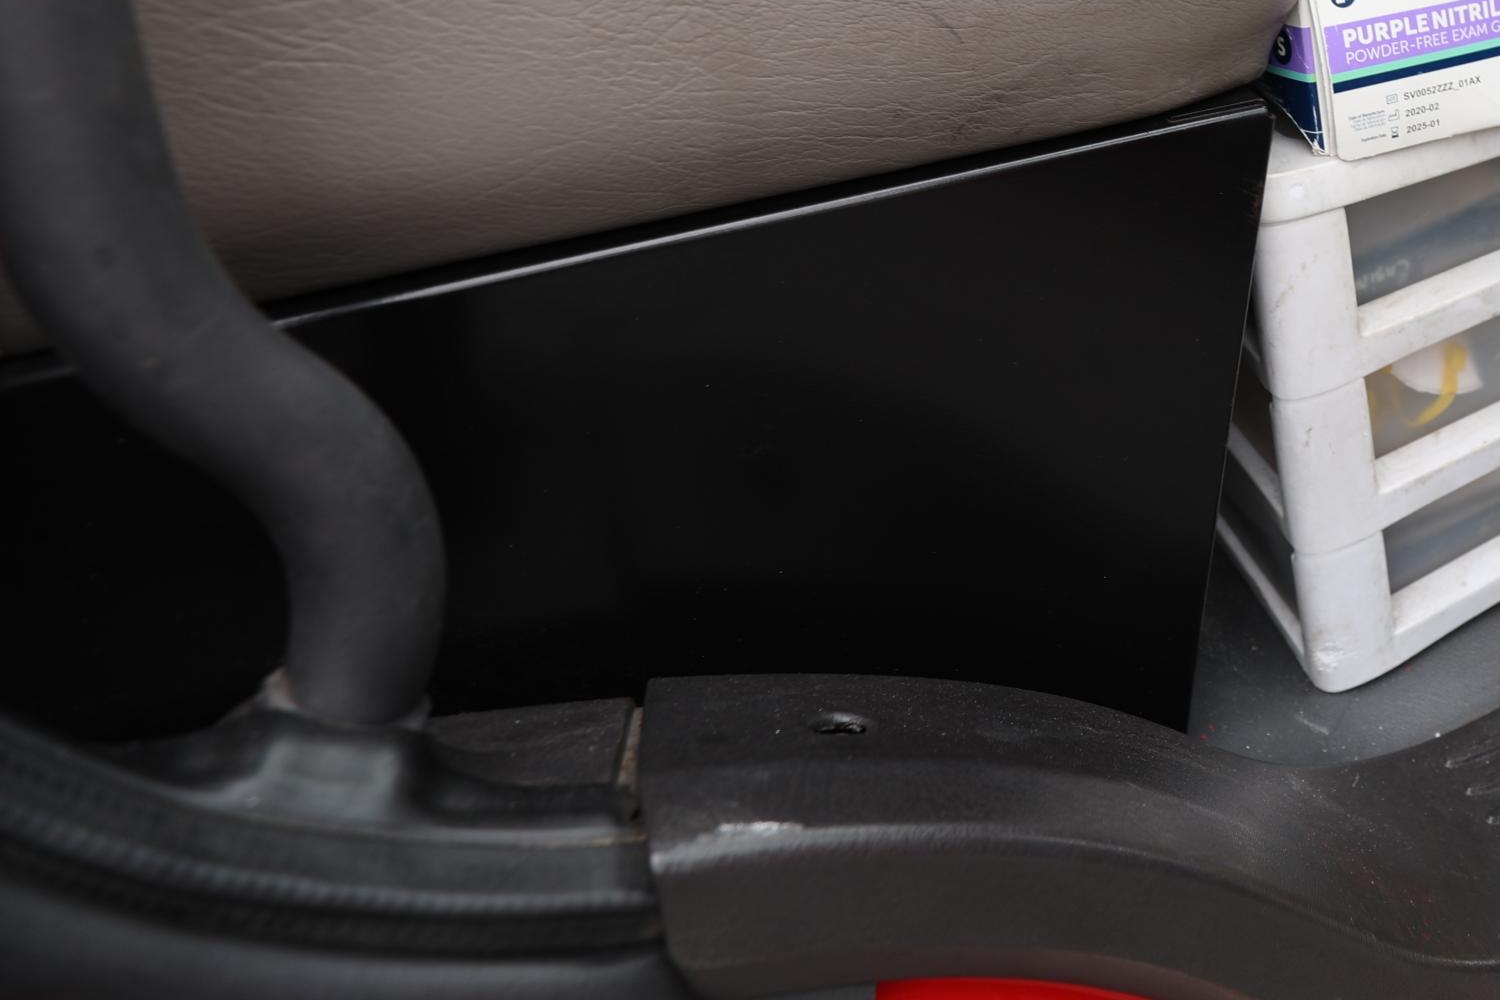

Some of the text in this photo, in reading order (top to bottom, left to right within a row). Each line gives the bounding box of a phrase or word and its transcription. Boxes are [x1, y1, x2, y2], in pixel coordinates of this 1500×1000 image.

[1342, 13, 1430, 49] PURPLE
[1346, 31, 1448, 65] POWDER-FREE
[1452, 23, 1488, 42] EXAM
[1405, 102, 1440, 117] 2020-02
[1406, 119, 1441, 134] 2025-01
